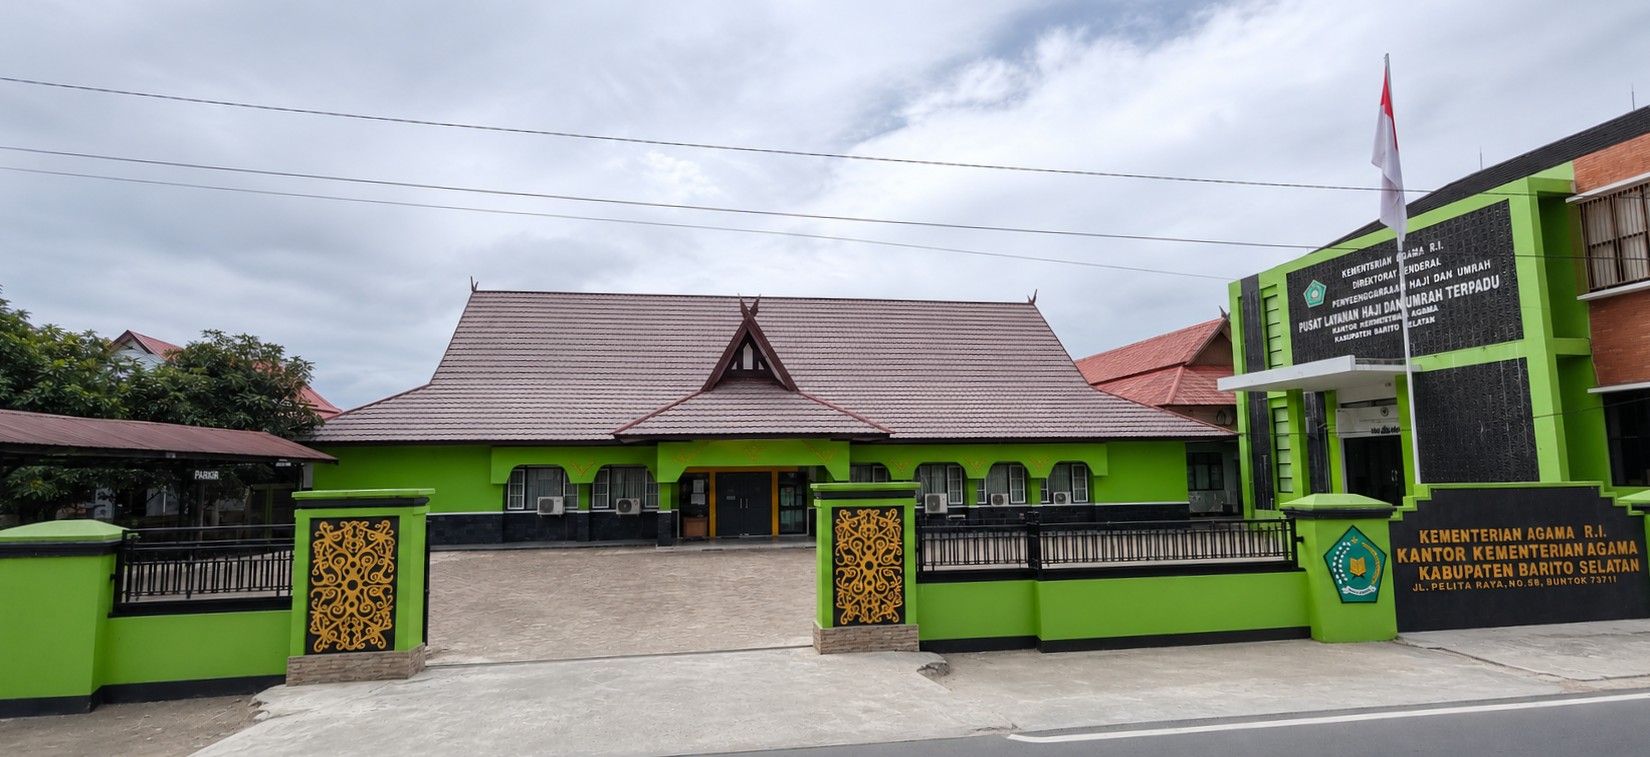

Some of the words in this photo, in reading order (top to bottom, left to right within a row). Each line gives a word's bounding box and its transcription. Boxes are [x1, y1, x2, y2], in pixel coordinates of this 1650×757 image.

[1341, 256, 1393, 279] KEMENTERIAN
[1429, 240, 1444, 253] R.I.
[1352, 269, 1398, 290] DIREKTORAT
[1399, 258, 1441, 276] ENDERAL
[1409, 275, 1430, 290] HAJI
[1433, 269, 1453, 283] DAN
[1457, 260, 1491, 277] UMRAH
[1298, 317, 1322, 333] PUSAT
[1323, 308, 1359, 327] LAYANAN
[1361, 303, 1382, 318] HAJI
[1383, 298, 1402, 314] DAN
[1405, 288, 1443, 309] UMRAH
[1445, 274, 1501, 299] TERPADU
[1373, 323, 1400, 336] BARITO
[1406, 316, 1436, 329] ELATAN
[1419, 527, 1522, 544] KEMENTERIAN
[1527, 526, 1575, 541] AGAMA
[1584, 524, 1607, 539] R.I.
[1396, 546, 1466, 564] KANTOR
[1472, 542, 1583, 561] KEMENTERIAN
[1587, 540, 1638, 556] AGAMA
[1418, 563, 1514, 581] KABUPATEN
[1518, 560, 1574, 577] BARITO
[1579, 558, 1640, 574] SELATAN
[1412, 583, 1429, 592] JL.
[1431, 581, 1472, 592] PELITA
[1546, 576, 1587, 587] BUNTOK
[1590, 575, 1617, 585] 73711
